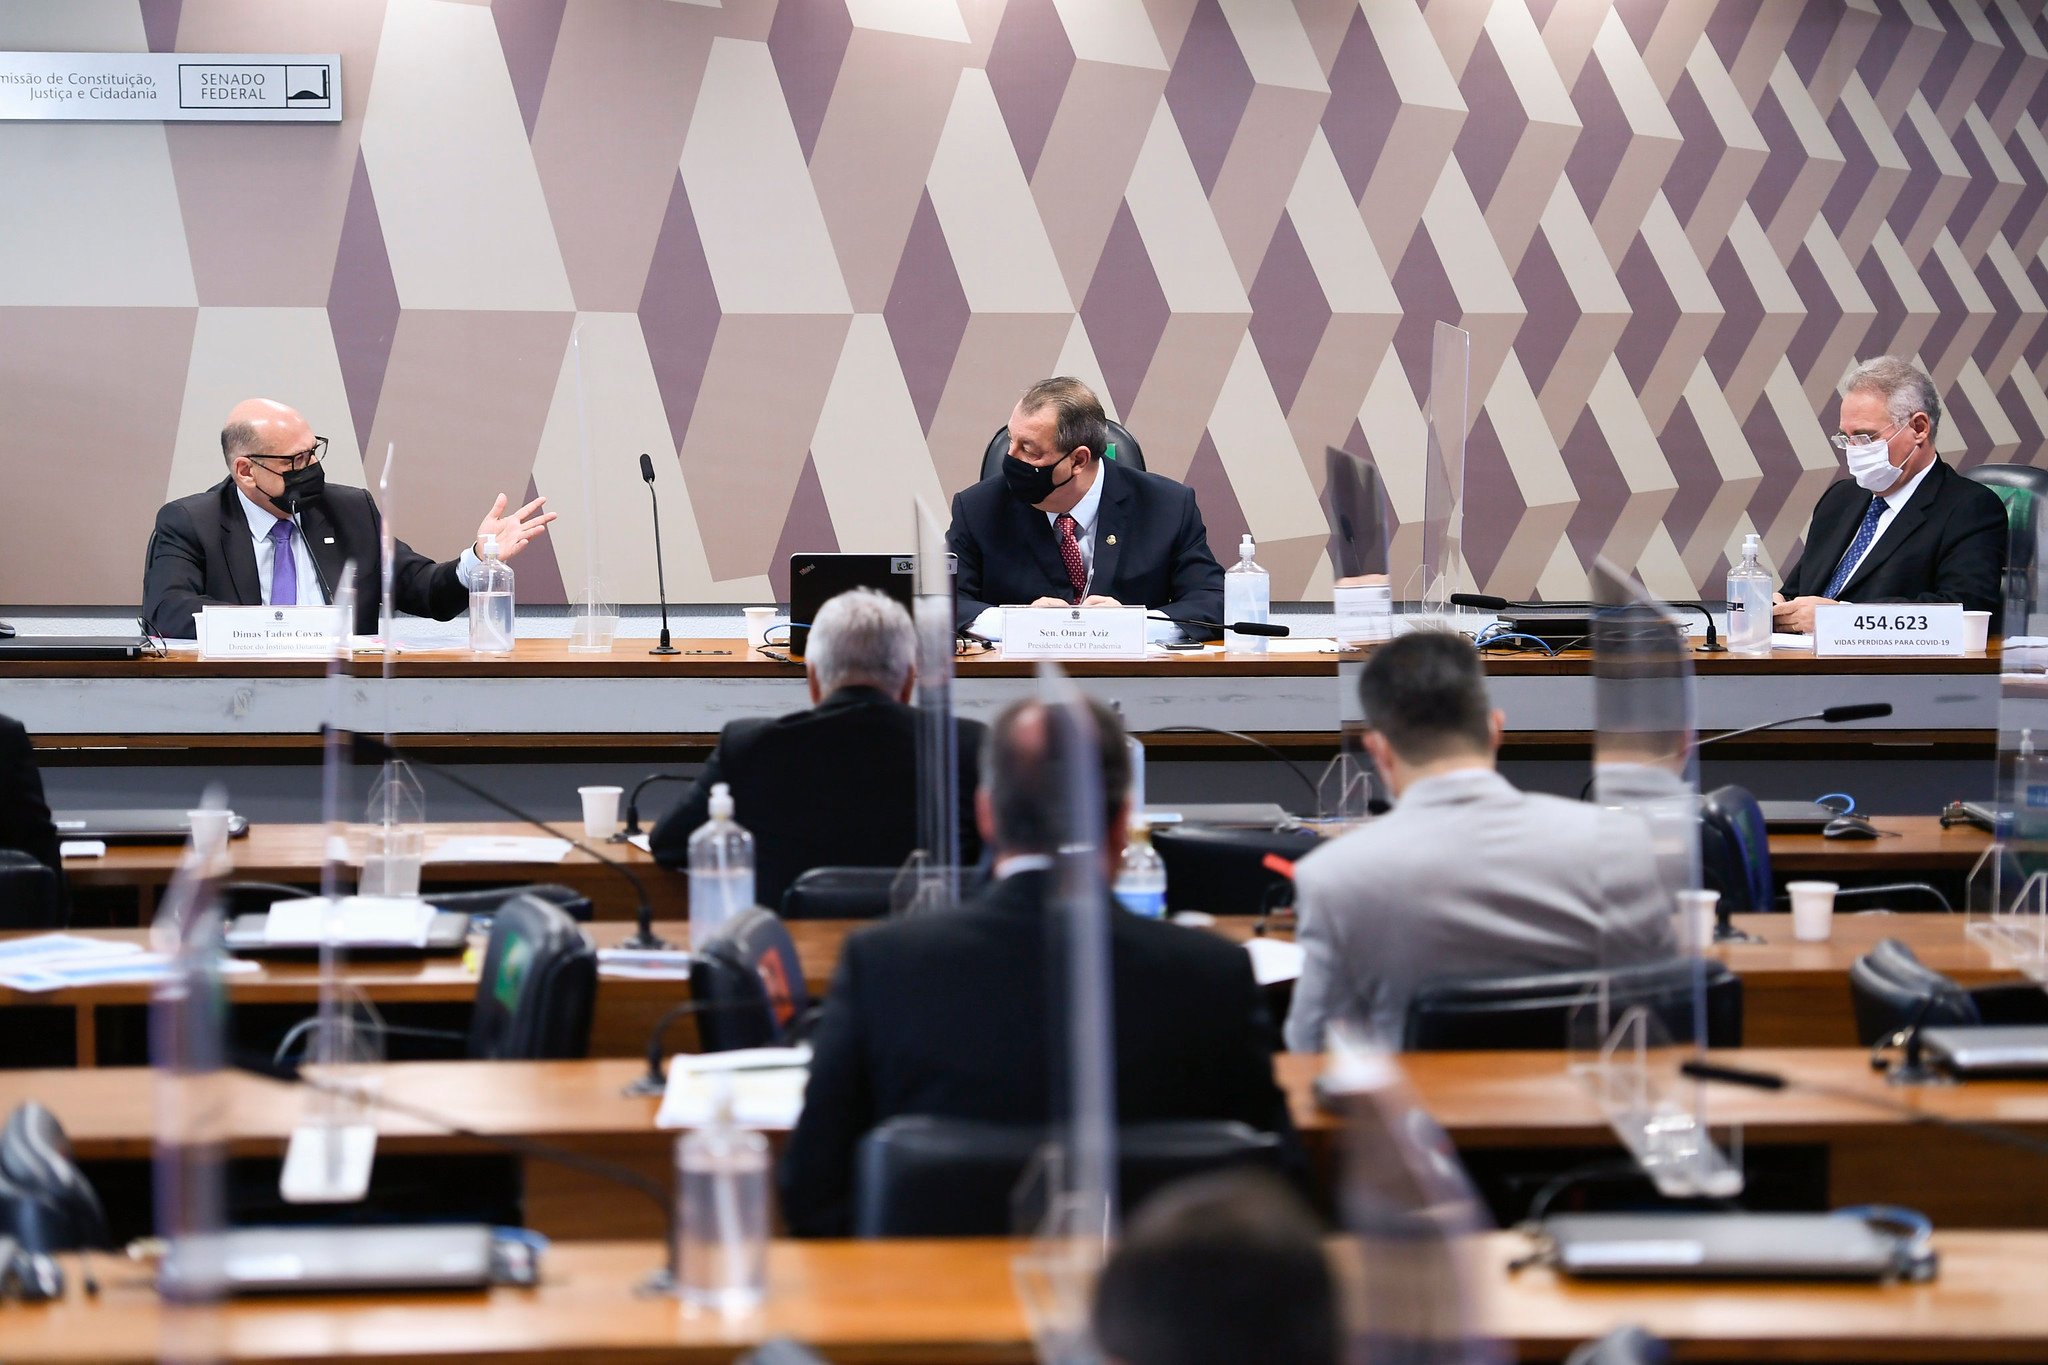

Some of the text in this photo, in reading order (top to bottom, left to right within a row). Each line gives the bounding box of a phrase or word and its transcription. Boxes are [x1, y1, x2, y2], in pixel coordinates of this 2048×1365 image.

[46, 72, 64, 85] de
[67, 72, 156, 88] Constituição,
[201, 73, 266, 86] SENADO
[29, 87, 157, 102] Justiça e Cidadania
[201, 87, 267, 100] FEDERAL
[1853, 615, 1929, 631] 454.623
[233, 629, 262, 638] Dimas
[295, 629, 323, 638] Covas
[1039, 628, 1110, 637] Sen. Omar Aziz
[255, 643, 264, 651] do
[1027, 642, 1122, 650] Presidente da CPI Pandemia
[1834, 638, 1950, 646] VIDAS PERDIDAS PARA COVID-19
